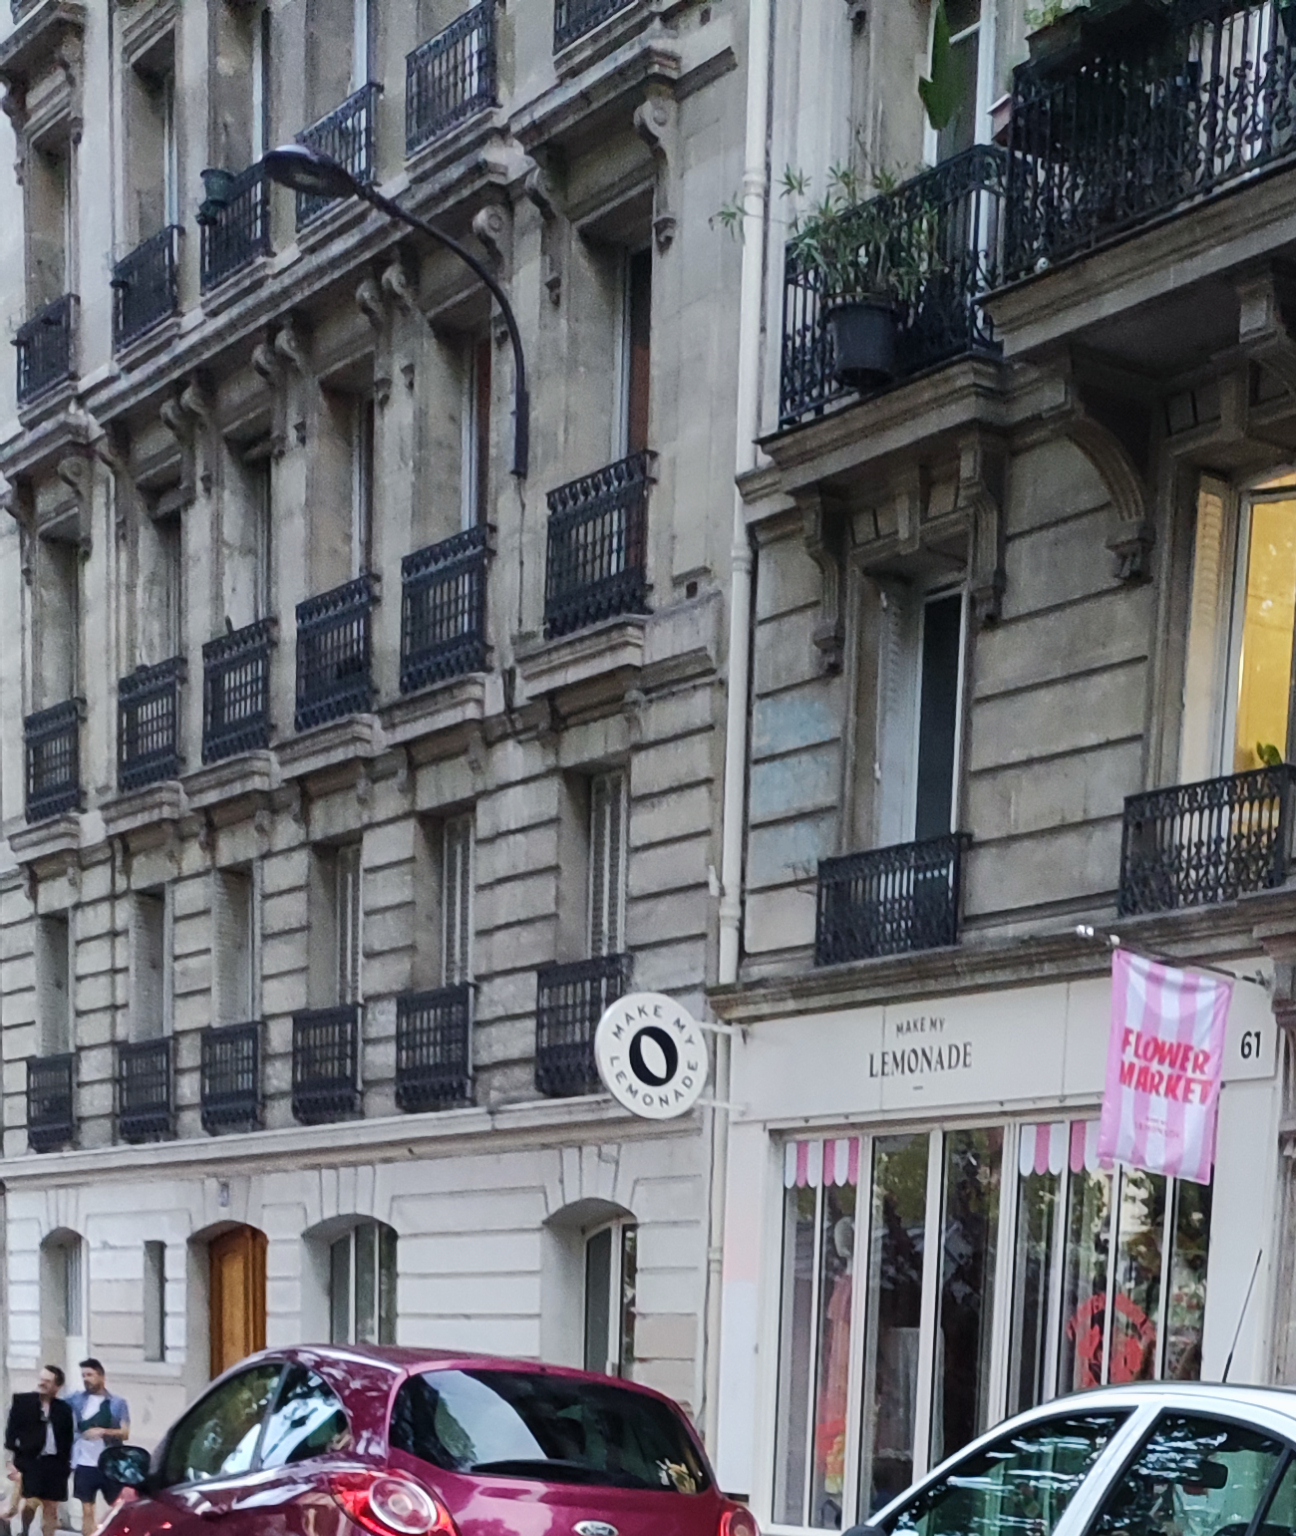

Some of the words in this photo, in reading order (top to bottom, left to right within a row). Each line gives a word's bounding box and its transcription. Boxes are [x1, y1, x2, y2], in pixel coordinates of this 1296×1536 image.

[611, 1004, 663, 1041] MAKE
[672, 1017, 696, 1046] MY
[895, 1016, 926, 1038] MAKE
[929, 1016, 946, 1033] MY
[1240, 1030, 1262, 1059] 61
[868, 1040, 973, 1079] LEMONADE
[1121, 1025, 1212, 1076] FLOWER
[610, 1055, 699, 1109] LEMONADE
[1119, 1058, 1214, 1106] MARKET
